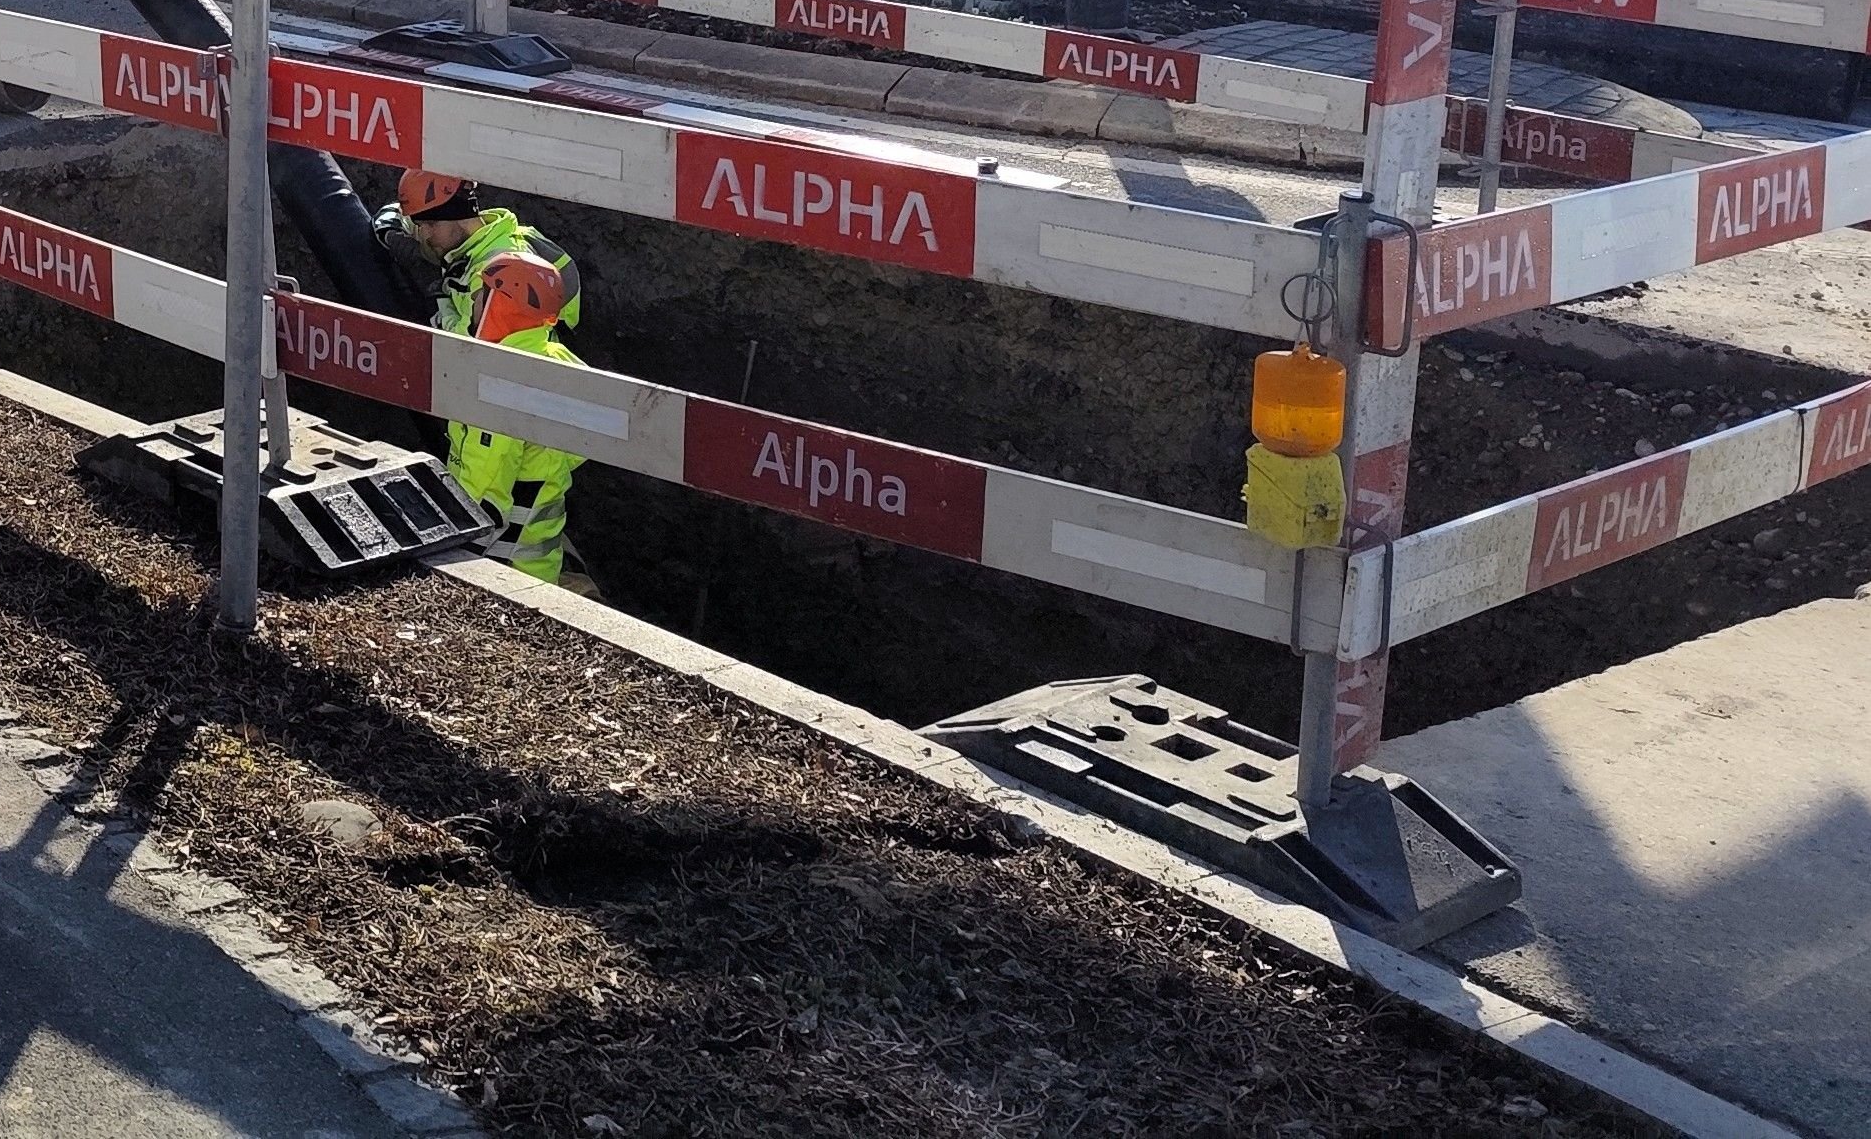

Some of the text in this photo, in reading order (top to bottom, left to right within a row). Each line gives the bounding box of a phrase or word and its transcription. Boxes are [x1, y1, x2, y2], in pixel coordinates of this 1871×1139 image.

[1058, 43, 1181, 91] ALPHA
[268, 77, 401, 152] LPHA
[700, 156, 942, 253] ALPHA
[1709, 165, 1813, 244] ALPHA
[0, 225, 102, 303] ALPHA
[752, 431, 907, 518] Alpha
[1543, 474, 1668, 569] ALPHA
